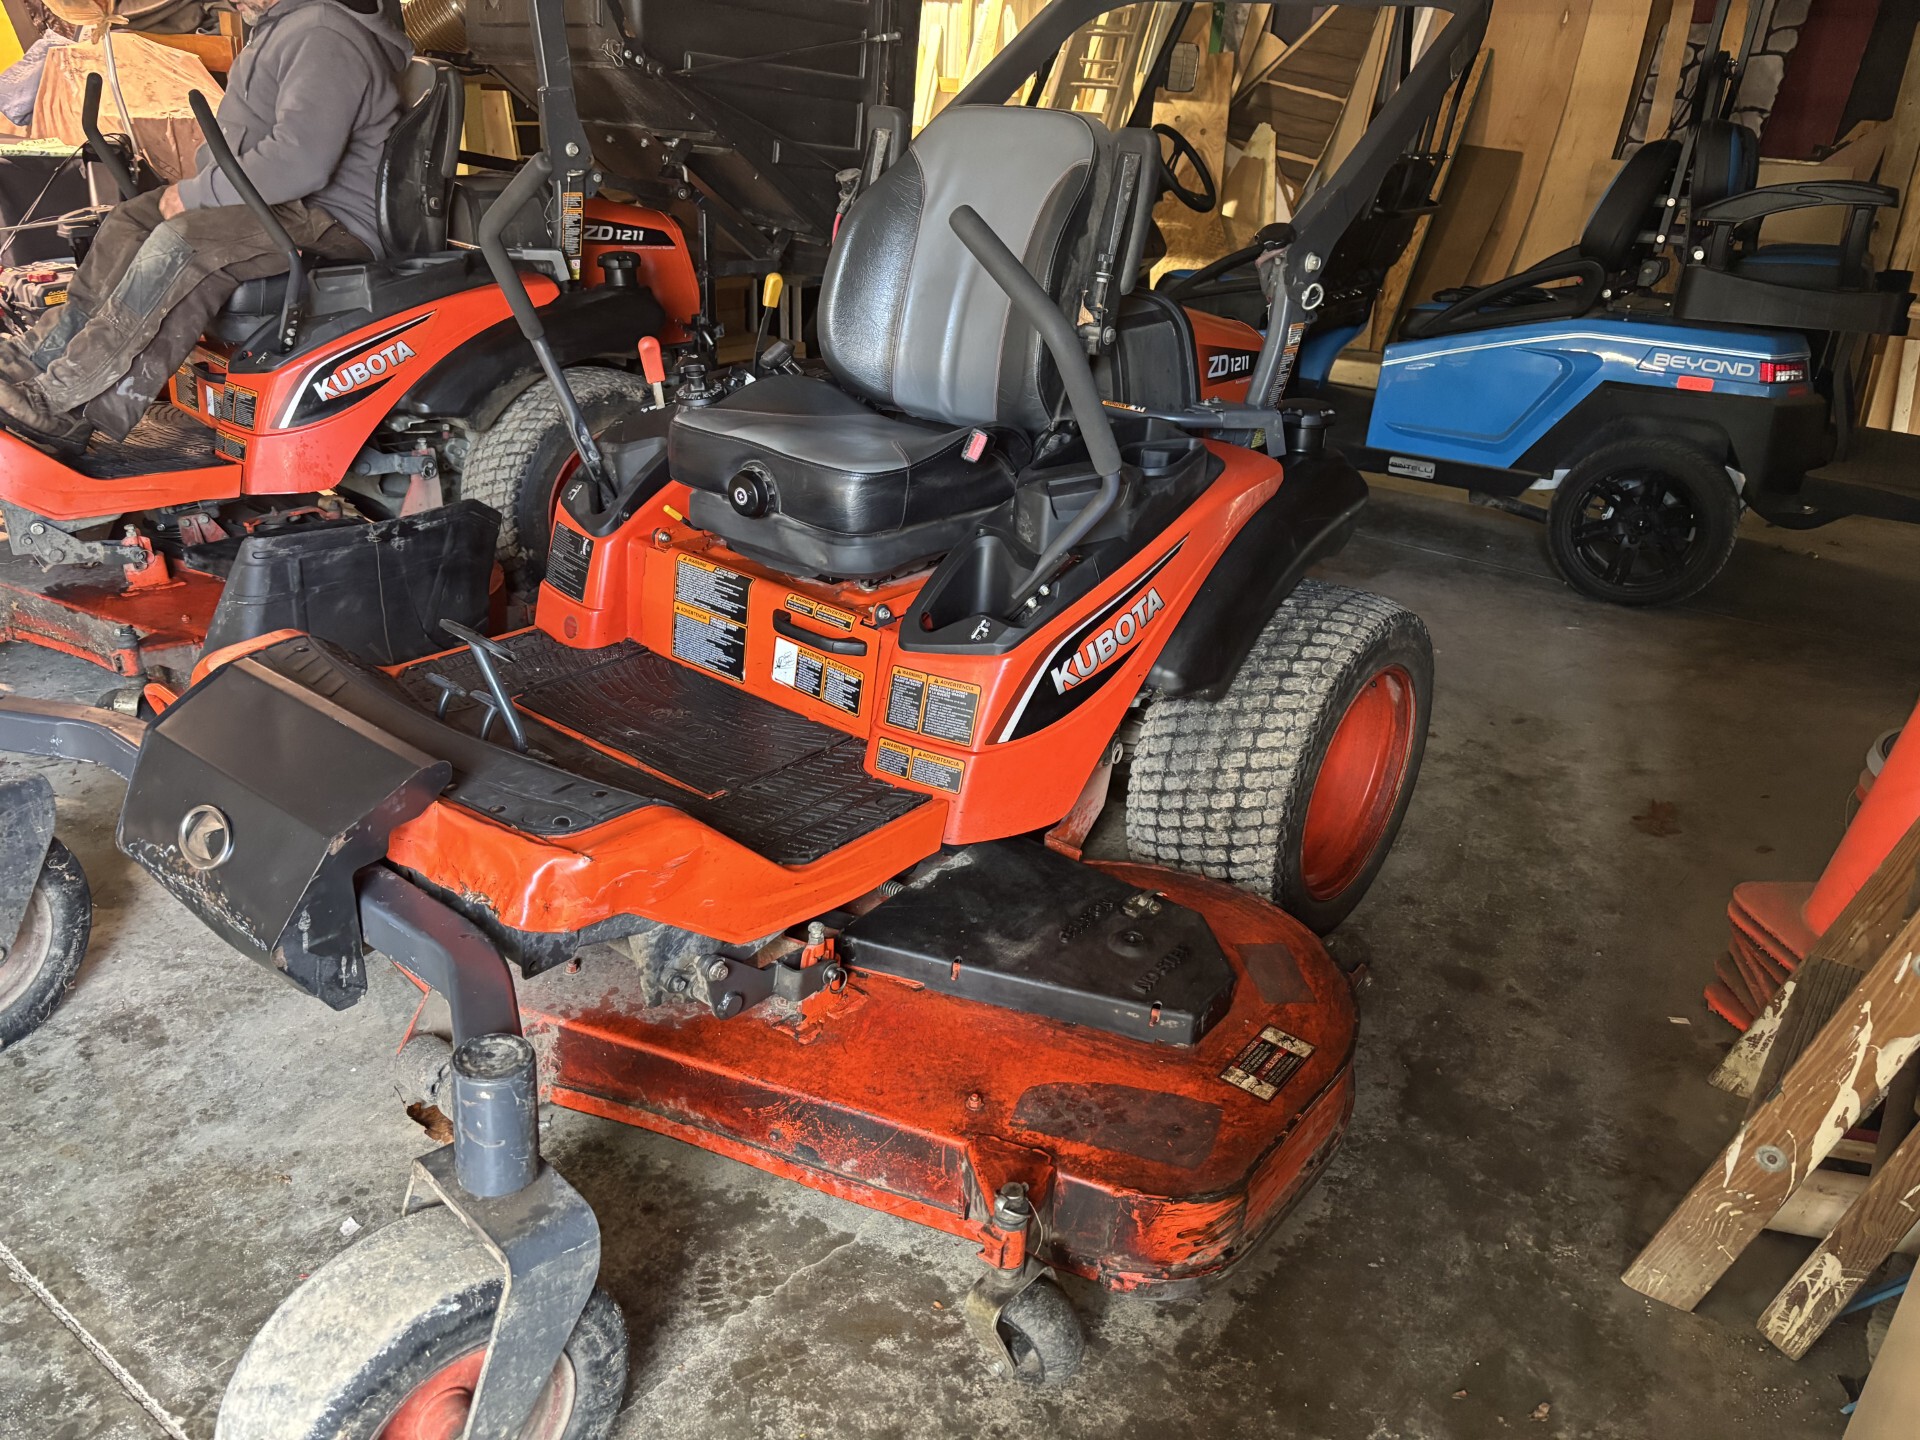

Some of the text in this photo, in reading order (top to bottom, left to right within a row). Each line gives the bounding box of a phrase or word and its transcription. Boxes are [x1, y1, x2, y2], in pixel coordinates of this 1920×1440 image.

[312, 340, 417, 402] KUBOTA
[1653, 353, 1755, 377] BEYOND
[1051, 587, 1166, 696] KUBOTA
[940, 679, 974, 692] ADVERTENCIA
[886, 741, 909, 753] WARNING
[923, 753, 960, 768] ADVERTENCIA
